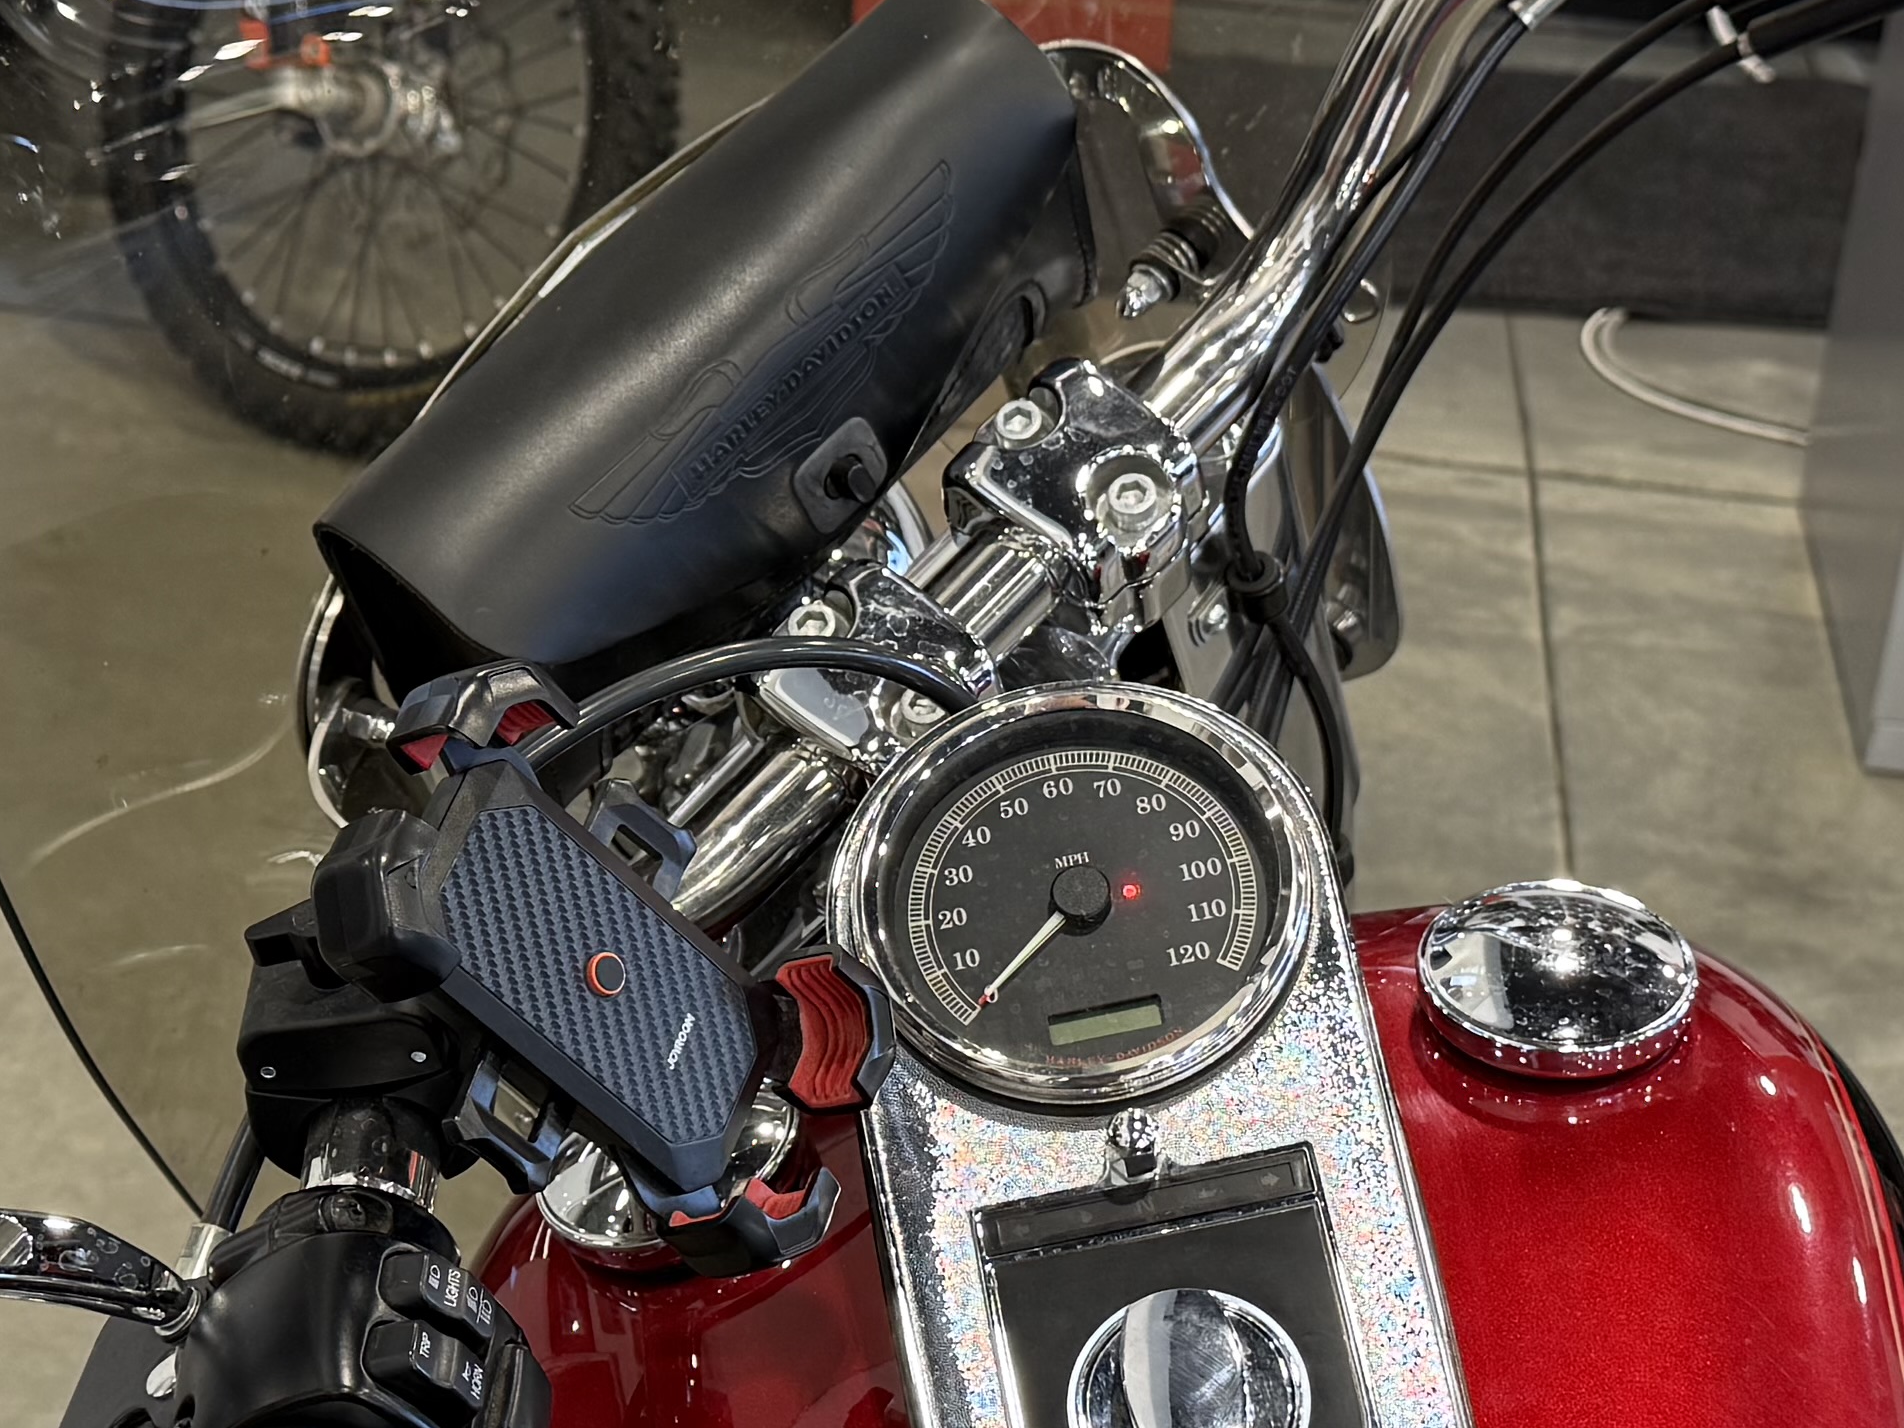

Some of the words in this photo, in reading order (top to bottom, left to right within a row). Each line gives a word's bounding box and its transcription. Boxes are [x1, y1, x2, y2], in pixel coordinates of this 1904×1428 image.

[1042, 777, 1074, 799] 60
[1093, 778, 1122, 798] 70
[999, 797, 1030, 819] 50
[1135, 793, 1167, 815] 80
[961, 826, 992, 848] 40
[1169, 819, 1201, 842] 90
[1054, 851, 1090, 870] MPH
[1178, 857, 1223, 882] 100
[944, 865, 974, 887] 30
[938, 907, 968, 930] 20
[1187, 898, 1228, 923] 110
[952, 948, 981, 971] 10
[1166, 940, 1211, 967] 120
[443, 1268, 462, 1307] LIGHTS
[419, 1331, 432, 1359] TRIP
[470, 1363, 485, 1401] HORN
